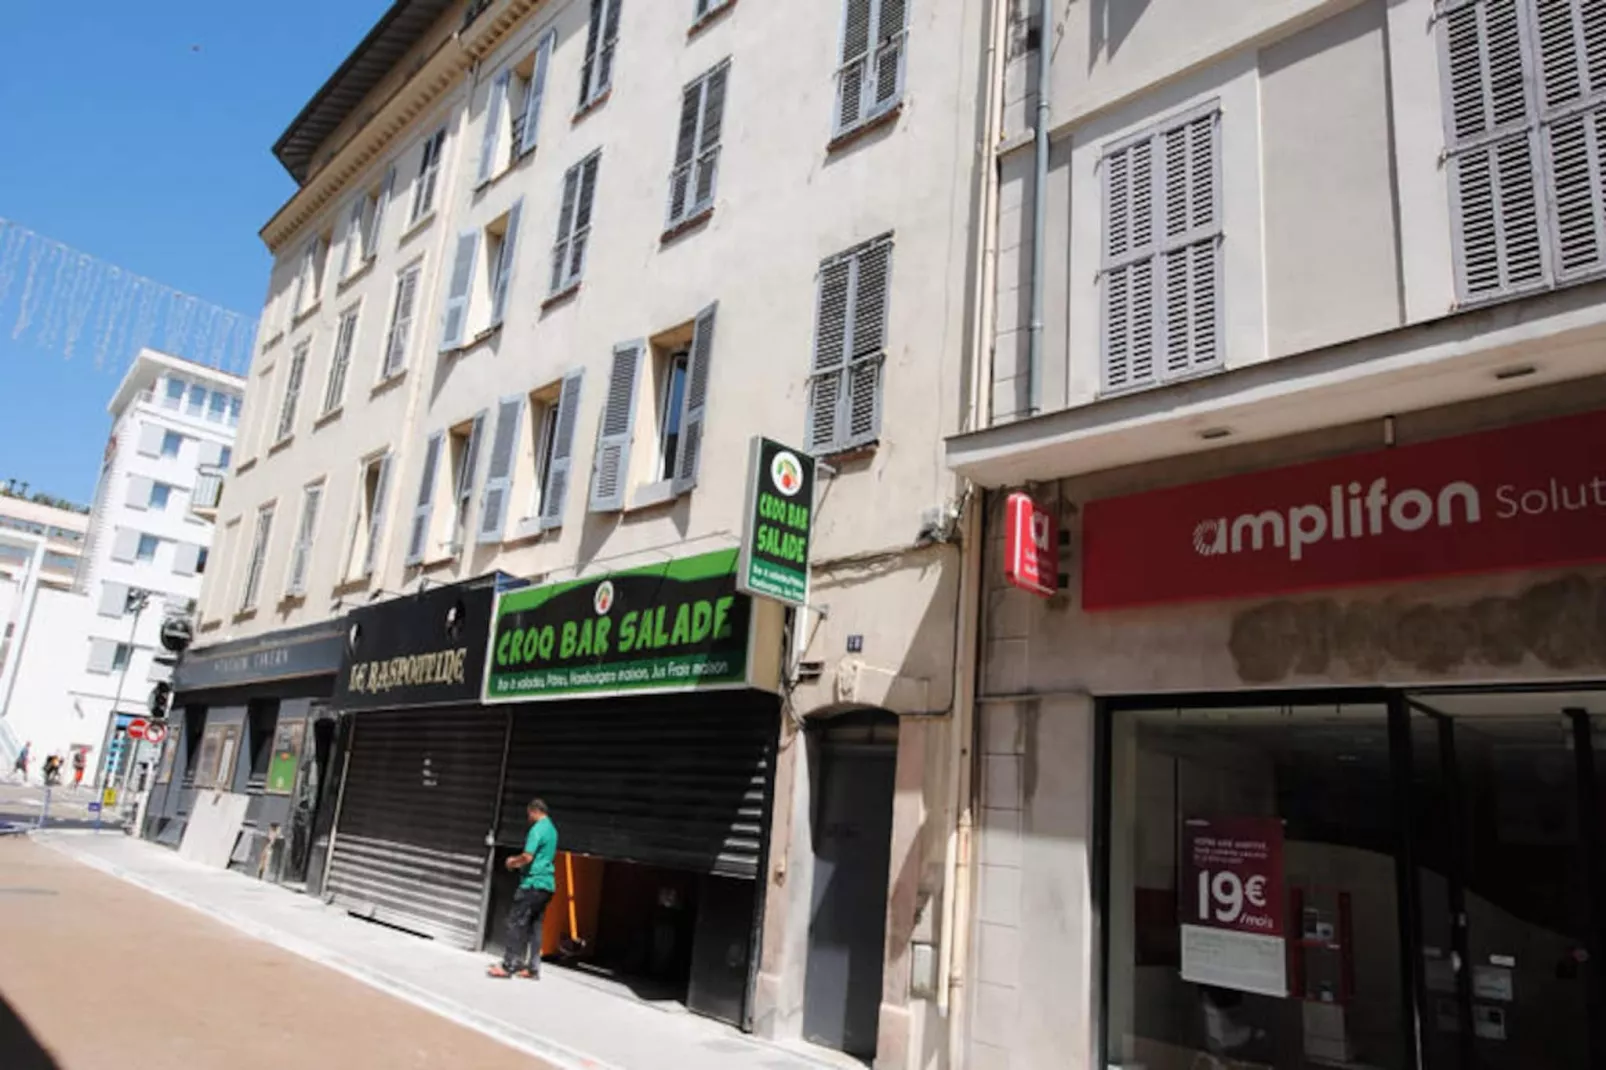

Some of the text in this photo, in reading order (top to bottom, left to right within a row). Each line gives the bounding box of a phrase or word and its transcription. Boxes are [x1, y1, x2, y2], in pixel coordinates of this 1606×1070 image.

[759, 492, 809, 530] CROQ BAR
[1192, 475, 1606, 561] amplifon Solut
[757, 524, 807, 563] SALADE
[496, 596, 734, 666] CROQ BAR SALADE
[1239, 912, 1274, 929] /mois
